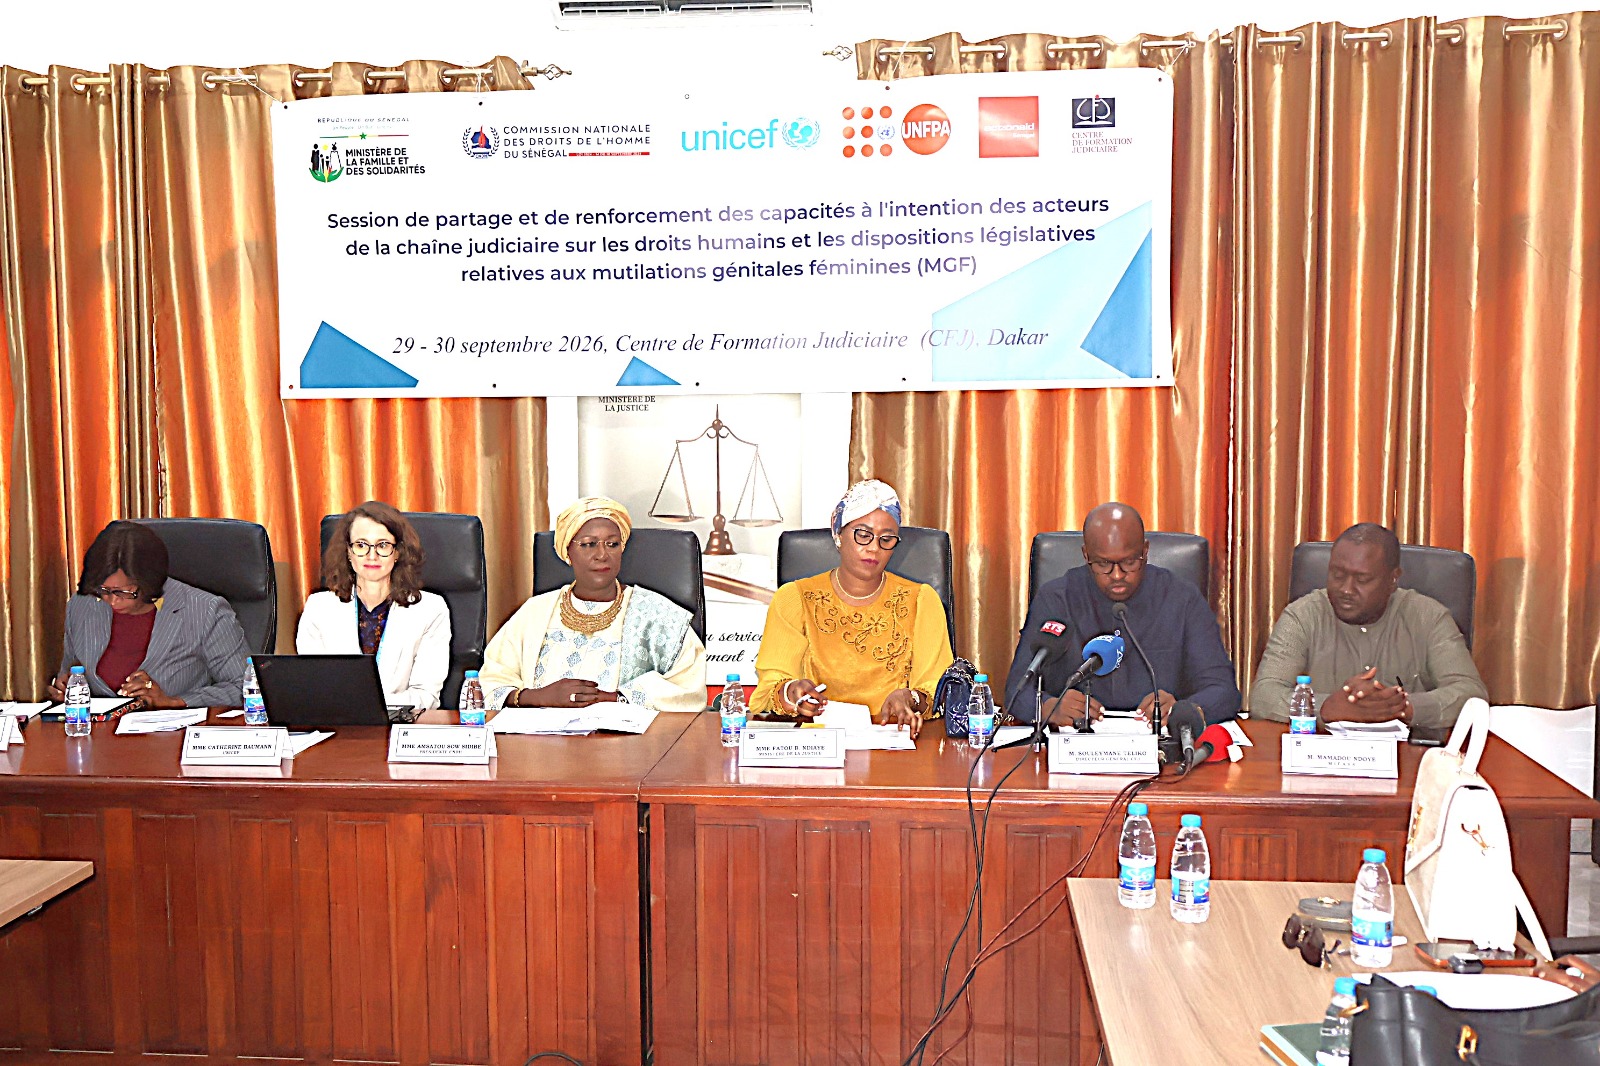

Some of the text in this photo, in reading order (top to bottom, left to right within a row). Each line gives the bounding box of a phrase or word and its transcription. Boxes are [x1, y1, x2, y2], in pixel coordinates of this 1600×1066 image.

[503, 124, 651, 134] COMMISSION NATIONALE
[681, 118, 779, 151] unicef
[902, 120, 951, 139] UNFPA
[1072, 131, 1104, 139] CENTRE
[504, 136, 651, 147] DES DROITS DE L'HOMME
[1085, 138, 1133, 146] FORMATION
[346, 147, 407, 157] MINISTÈRE DE
[504, 150, 519, 159] DU
[522, 148, 568, 158] SÉNÉGAL
[1072, 145, 1118, 154] JUDICIAIRE
[346, 157, 409, 166] LA FAMILLE ET
[346, 164, 426, 176] DES SOLIDARITÉS
[328, 198, 1109, 230] Session de partage et de renforcement des capacités à l'intention des acteurs
[346, 225, 1095, 258] de la chaîne judiciaire sur les droits humains et les dispositions législatives
[462, 256, 976, 282] relatives aux mutilations génitales féminines (MGF)
[392, 337, 414, 353] 29
[434, 337, 455, 353] 30
[460, 336, 552, 357] septembre
[559, 335, 607, 354] 2026,
[616, 335, 676, 351] Centre
[683, 334, 704, 350] de
[710, 334, 806, 350] Formation
[813, 331, 907, 348] Judiciaire
[988, 328, 1048, 345] Dakar
[644, 395, 656, 403] DE
[616, 404, 650, 413] JUSTICE
[1042, 622, 1066, 633] RTS
